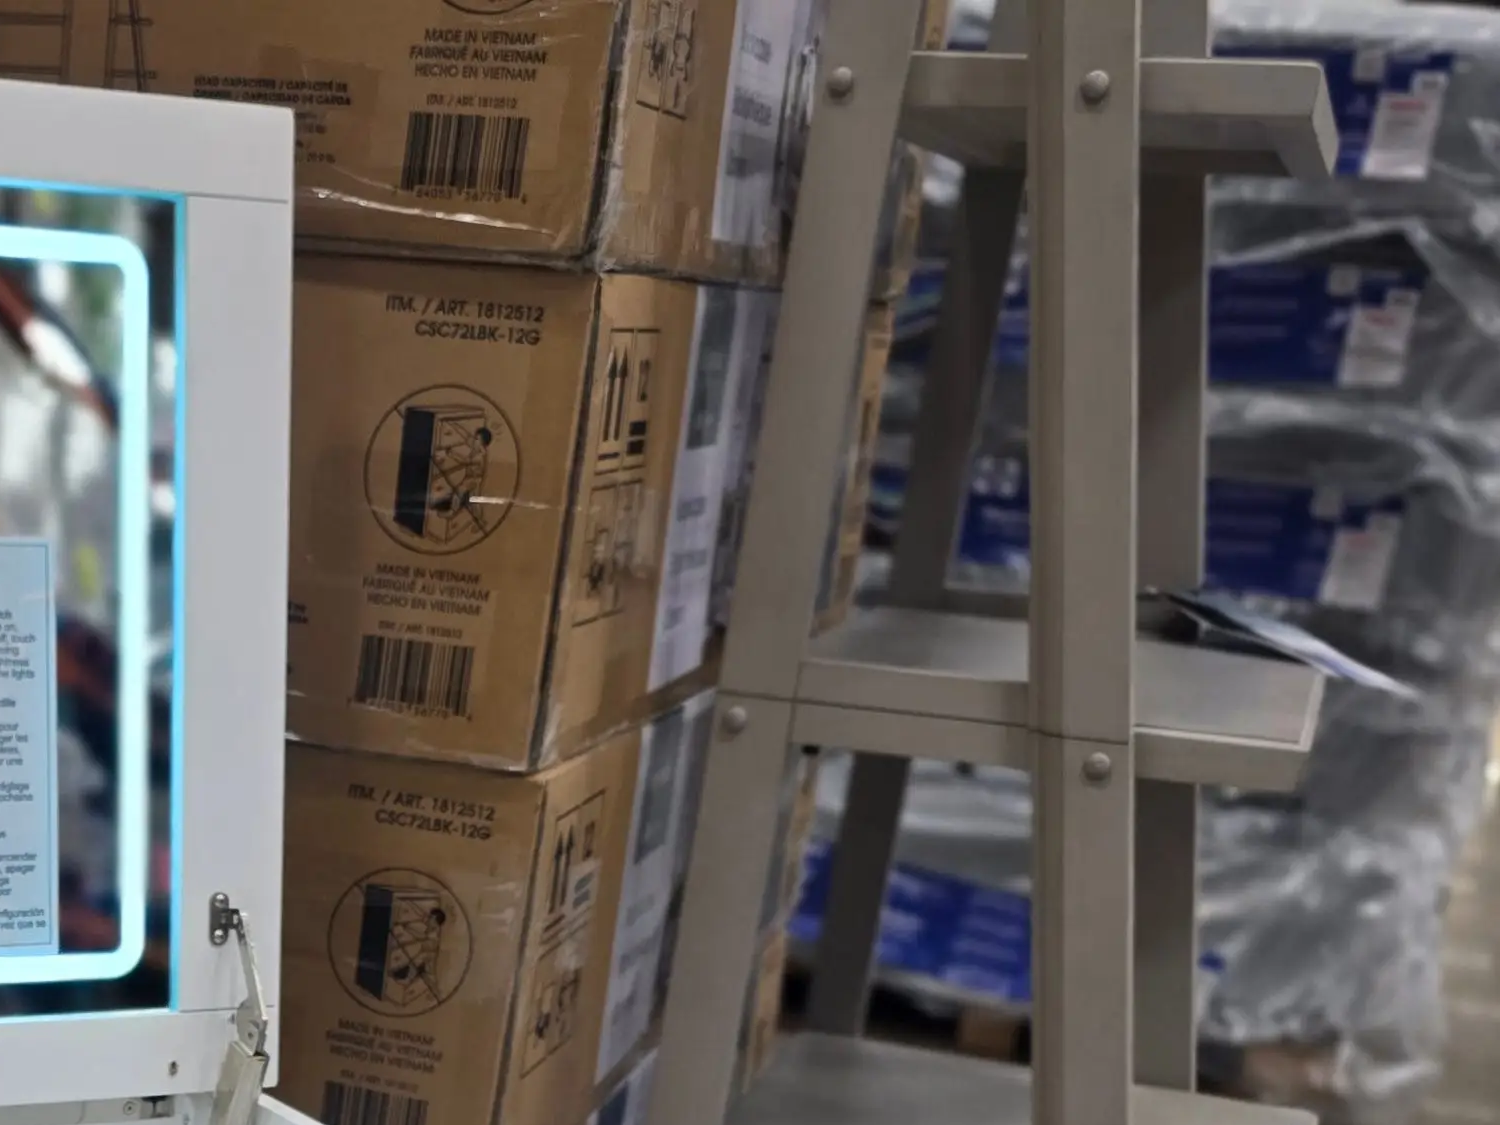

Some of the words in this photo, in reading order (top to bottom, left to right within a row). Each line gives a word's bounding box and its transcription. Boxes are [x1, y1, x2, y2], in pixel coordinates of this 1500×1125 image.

[424, 28, 462, 44] MADE
[464, 29, 478, 44] IN
[481, 30, 537, 47] VIETNAM
[409, 45, 469, 62] FABRIQUÉ
[471, 48, 490, 62] AU
[492, 49, 548, 65] VIETNAM
[414, 63, 459, 79] HECHO
[461, 65, 479, 80] EN
[482, 66, 538, 83] VIETNAM
[385, 294, 417, 313] ITM.
[434, 298, 470, 318] ART.
[428, 567, 482, 585] VIETNAM
[438, 584, 491, 603] VIETNAM
[429, 598, 483, 616] VIETNAM
[393, 790, 426, 811] ART.
[431, 797, 497, 822] 1812512
